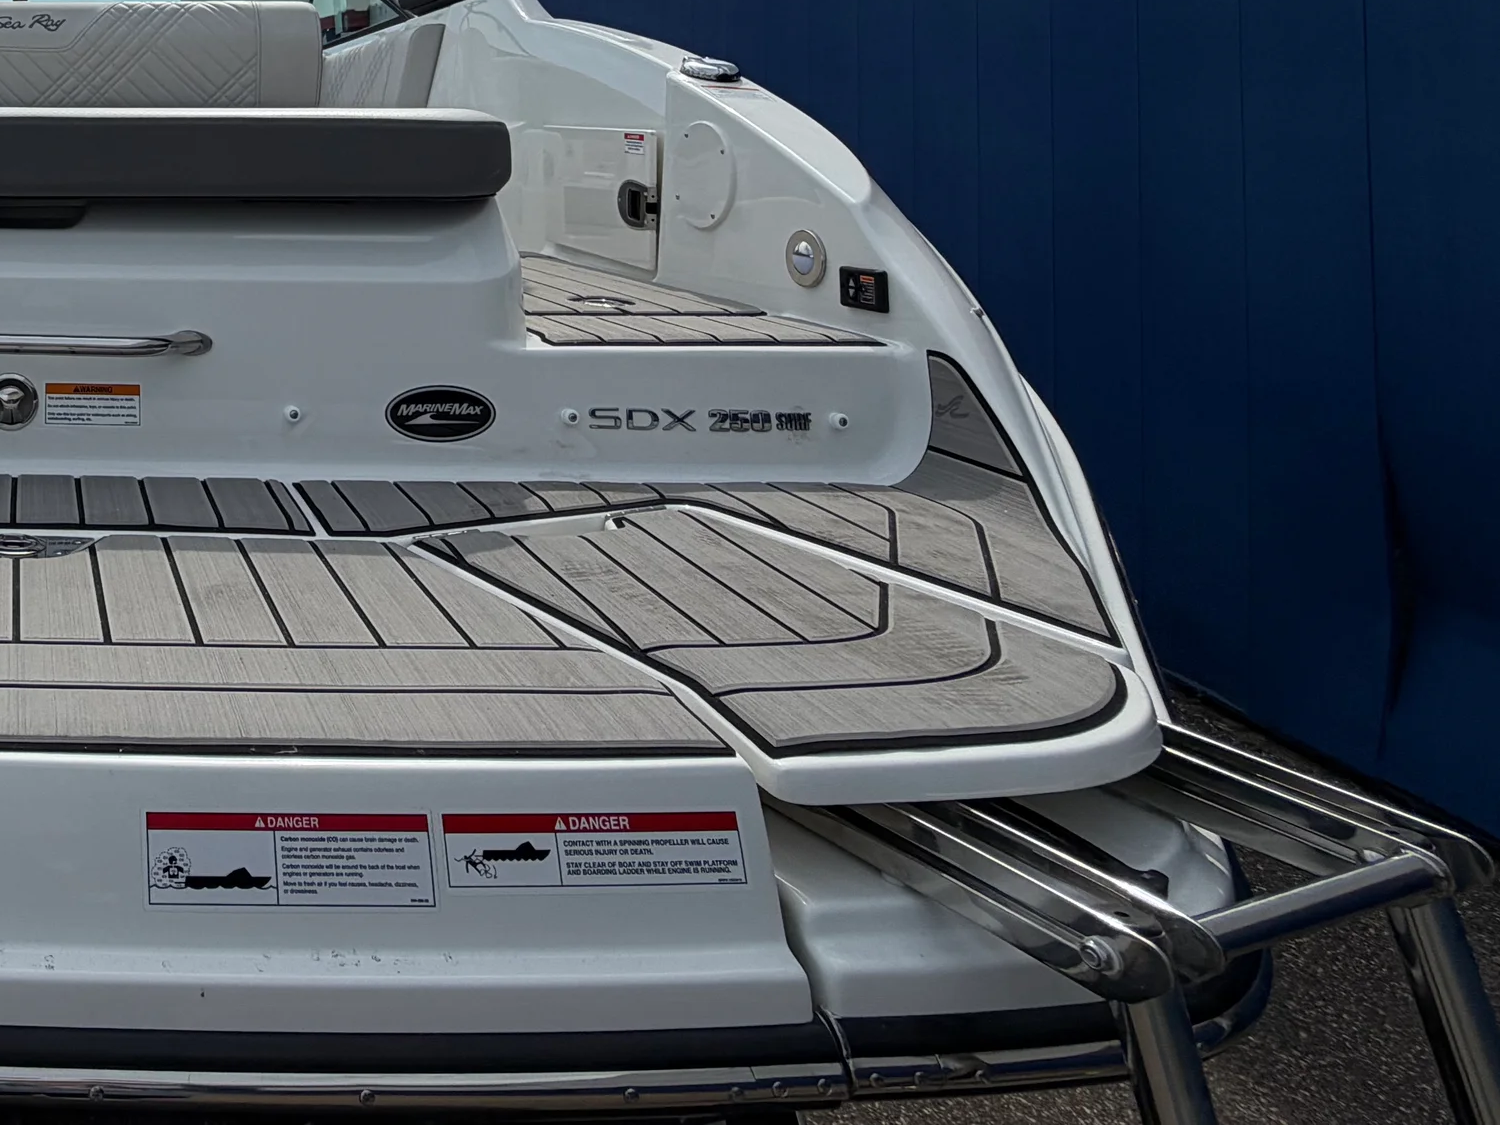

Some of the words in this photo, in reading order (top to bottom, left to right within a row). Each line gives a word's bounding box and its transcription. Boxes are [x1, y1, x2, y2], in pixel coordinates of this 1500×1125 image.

[28, 14, 66, 31] Ray
[588, 408, 696, 431] SDX
[708, 409, 772, 432] 250
[267, 816, 319, 828] DANGER
[569, 817, 630, 830] DANGER
